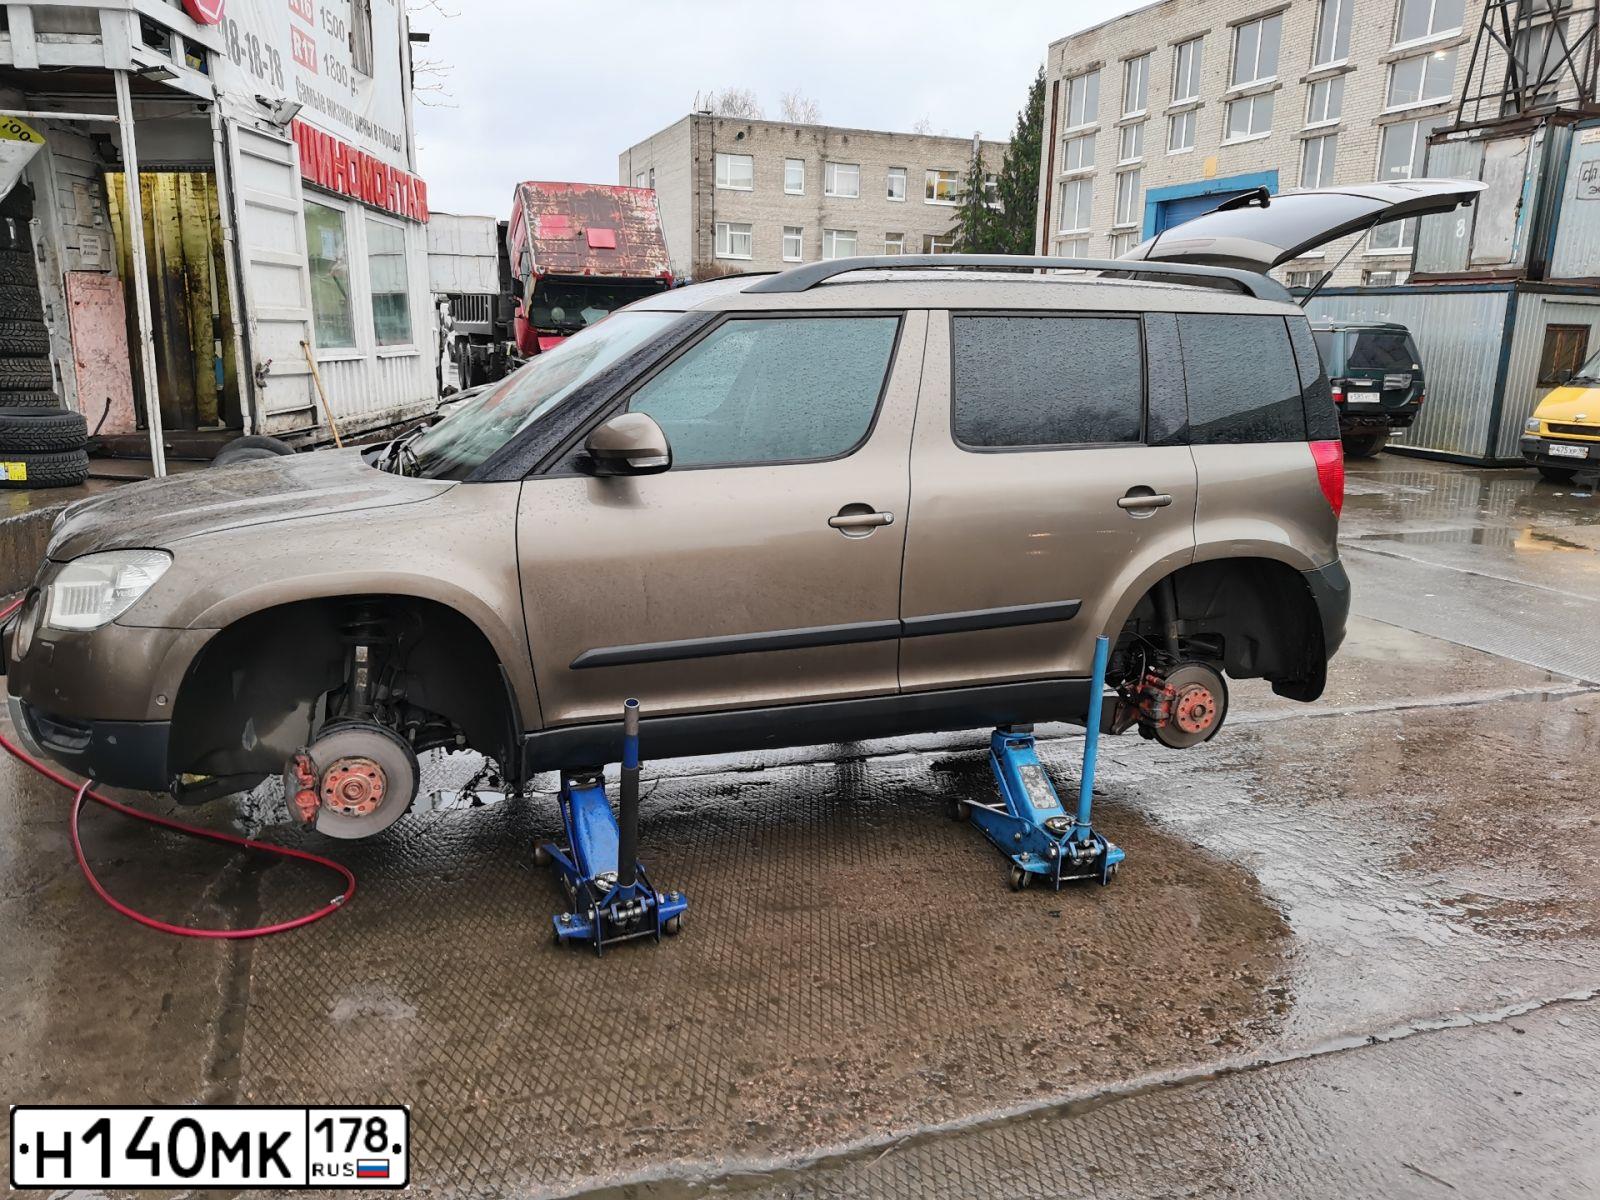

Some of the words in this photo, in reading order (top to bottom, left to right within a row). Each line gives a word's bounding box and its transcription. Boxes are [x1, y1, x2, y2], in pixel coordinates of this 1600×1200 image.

[320, 6, 345, 42] 1500
[293, 28, 315, 67] R17
[324, 53, 348, 87] 1800
[296, 75, 326, 114] Самые
[354, 112, 373, 139] цены
[291, 118, 430, 224] ШИНОМОНТАЖ
